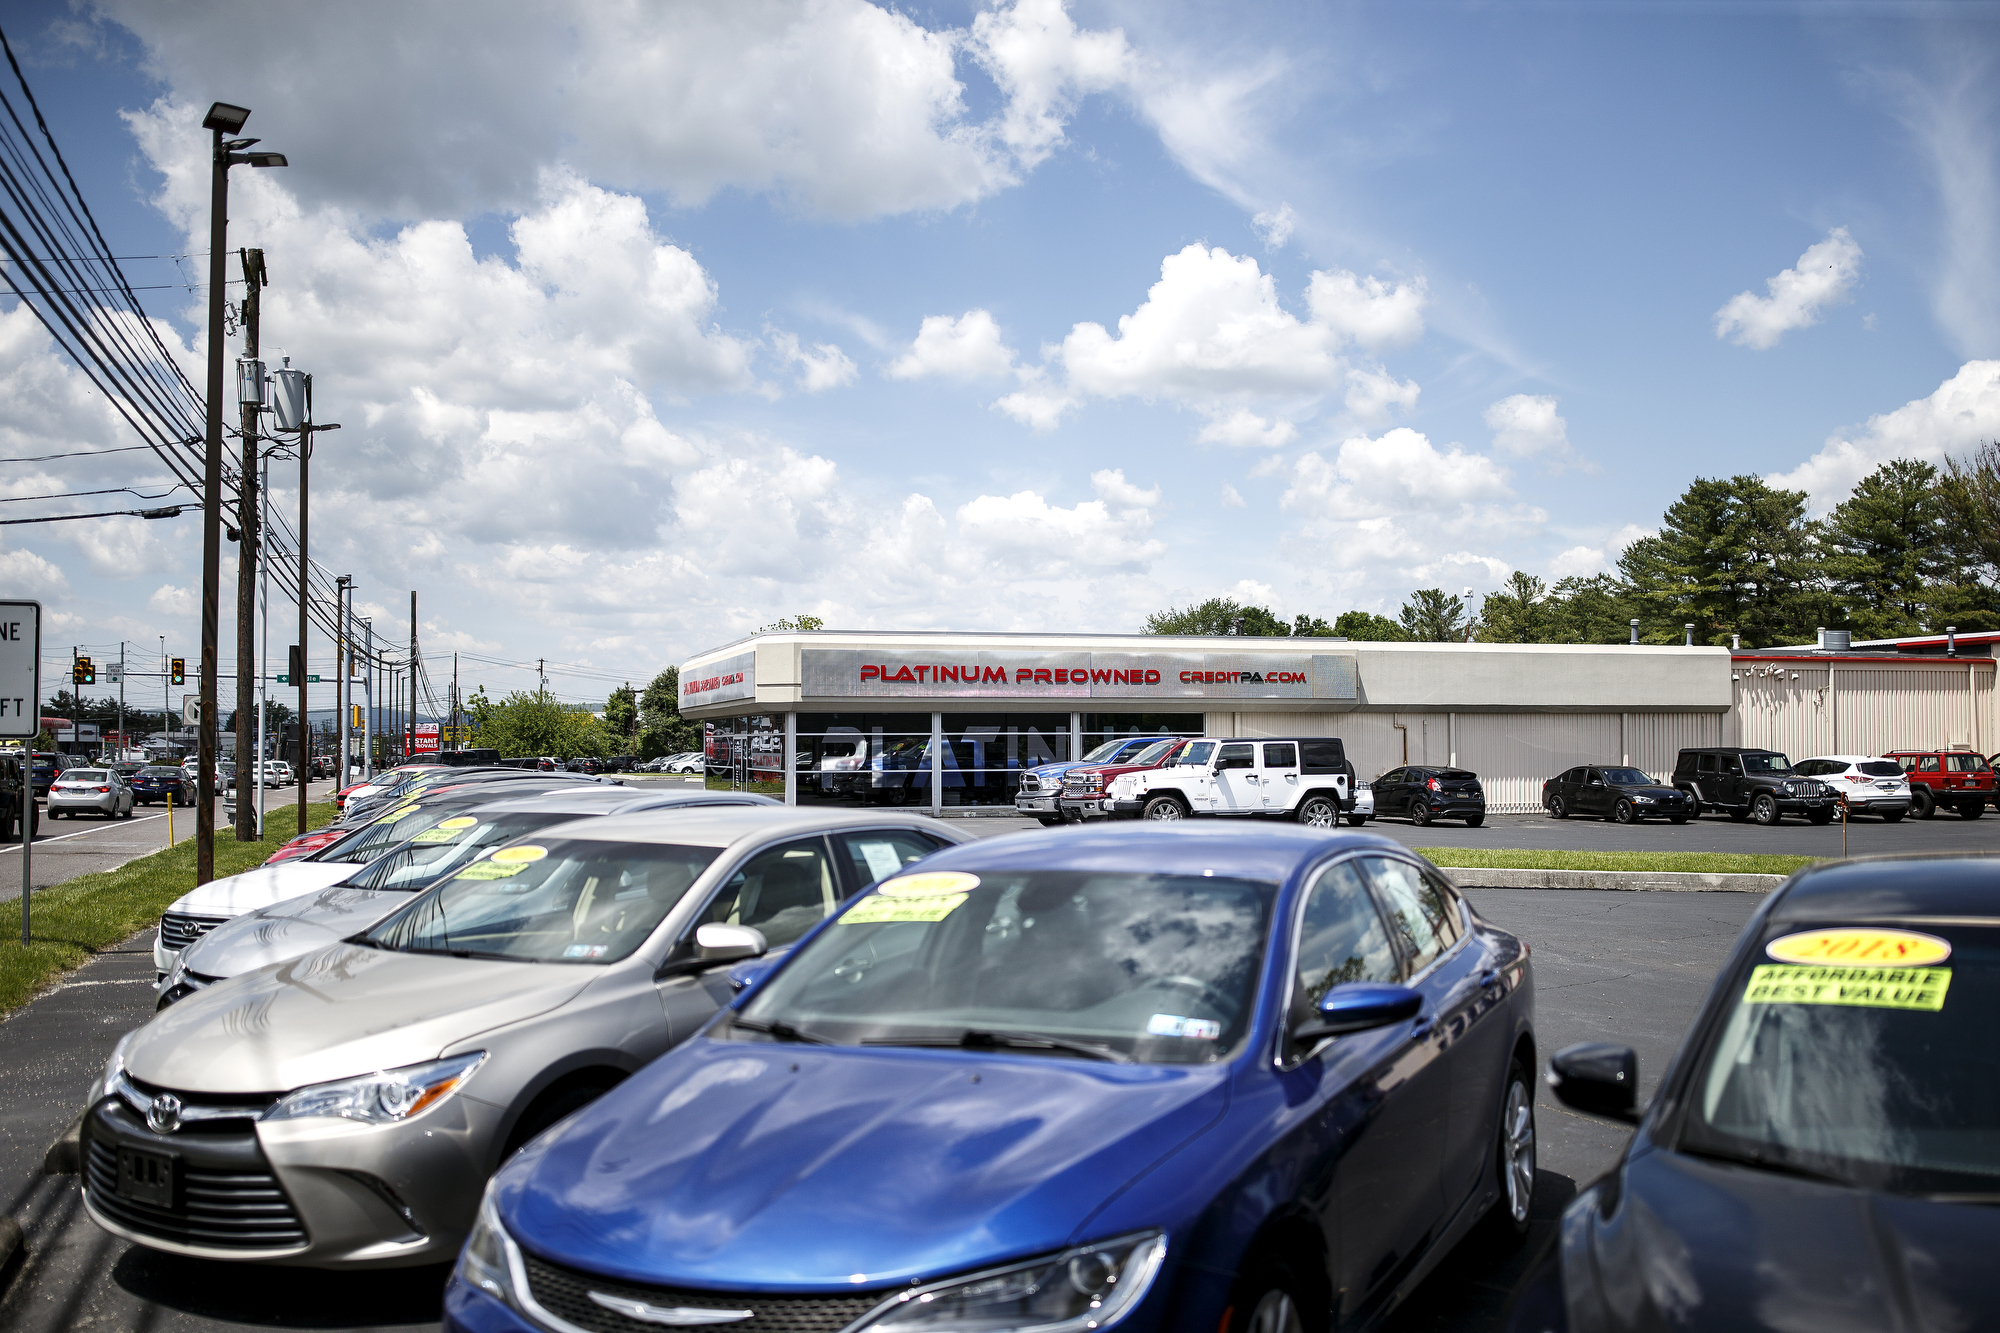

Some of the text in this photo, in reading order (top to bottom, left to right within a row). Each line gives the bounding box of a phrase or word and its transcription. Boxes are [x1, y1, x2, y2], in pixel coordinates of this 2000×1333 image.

[860, 664, 1306, 685] PLATINUM PREOWNED CREDITPA.COM
[1799, 938, 1919, 958] 2018
[1750, 983, 1938, 1004] BEST VALUE
